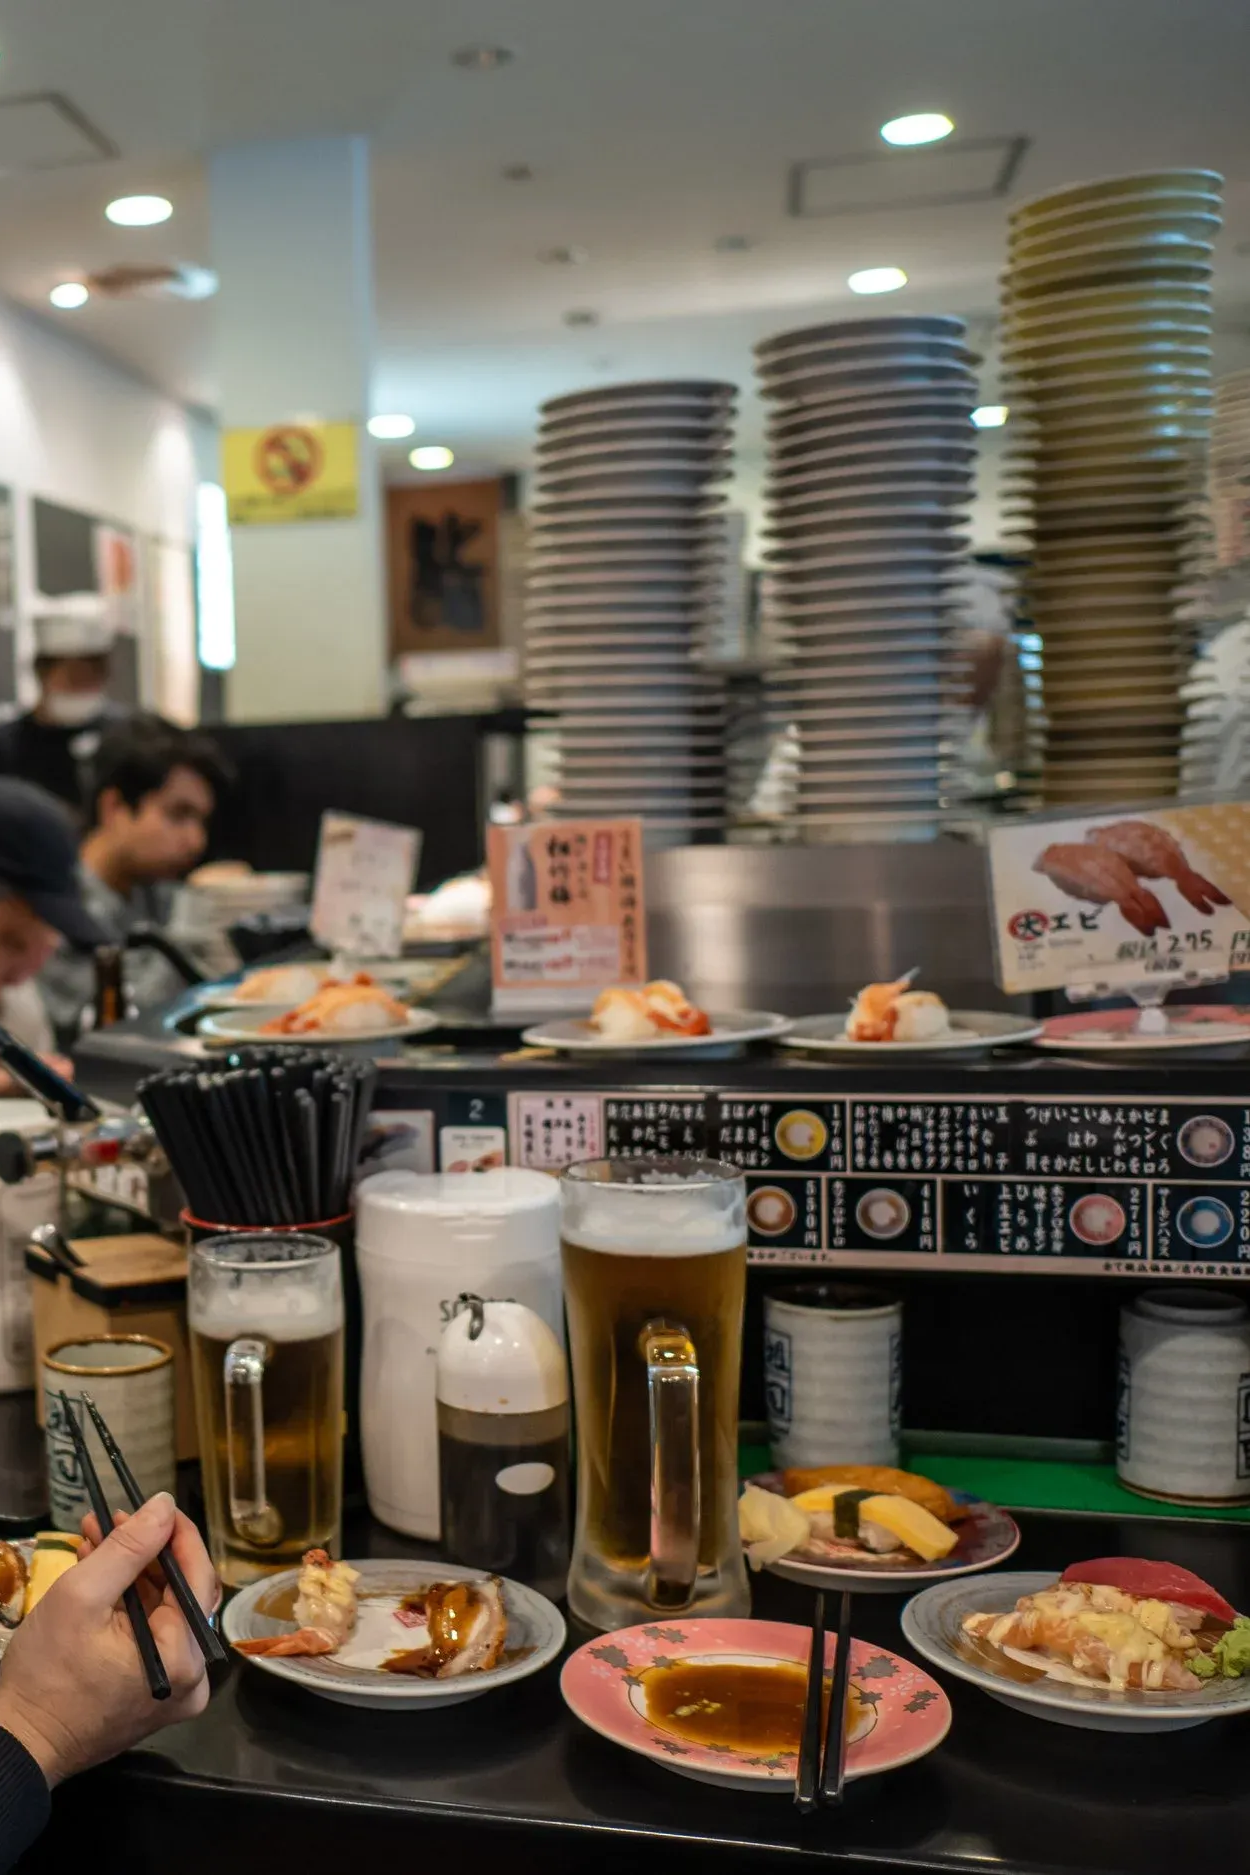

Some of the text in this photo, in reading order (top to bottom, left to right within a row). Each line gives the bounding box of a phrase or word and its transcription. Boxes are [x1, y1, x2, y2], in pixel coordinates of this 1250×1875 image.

[468, 1098, 484, 1121] 2
[1053, 1106, 1068, 1173] いか
[1083, 1106, 1098, 1174] いわし
[963, 1183, 979, 1250] いくら
[1015, 1183, 1031, 1252] ひらめ
[1128, 1187, 1142, 1257] 275円
